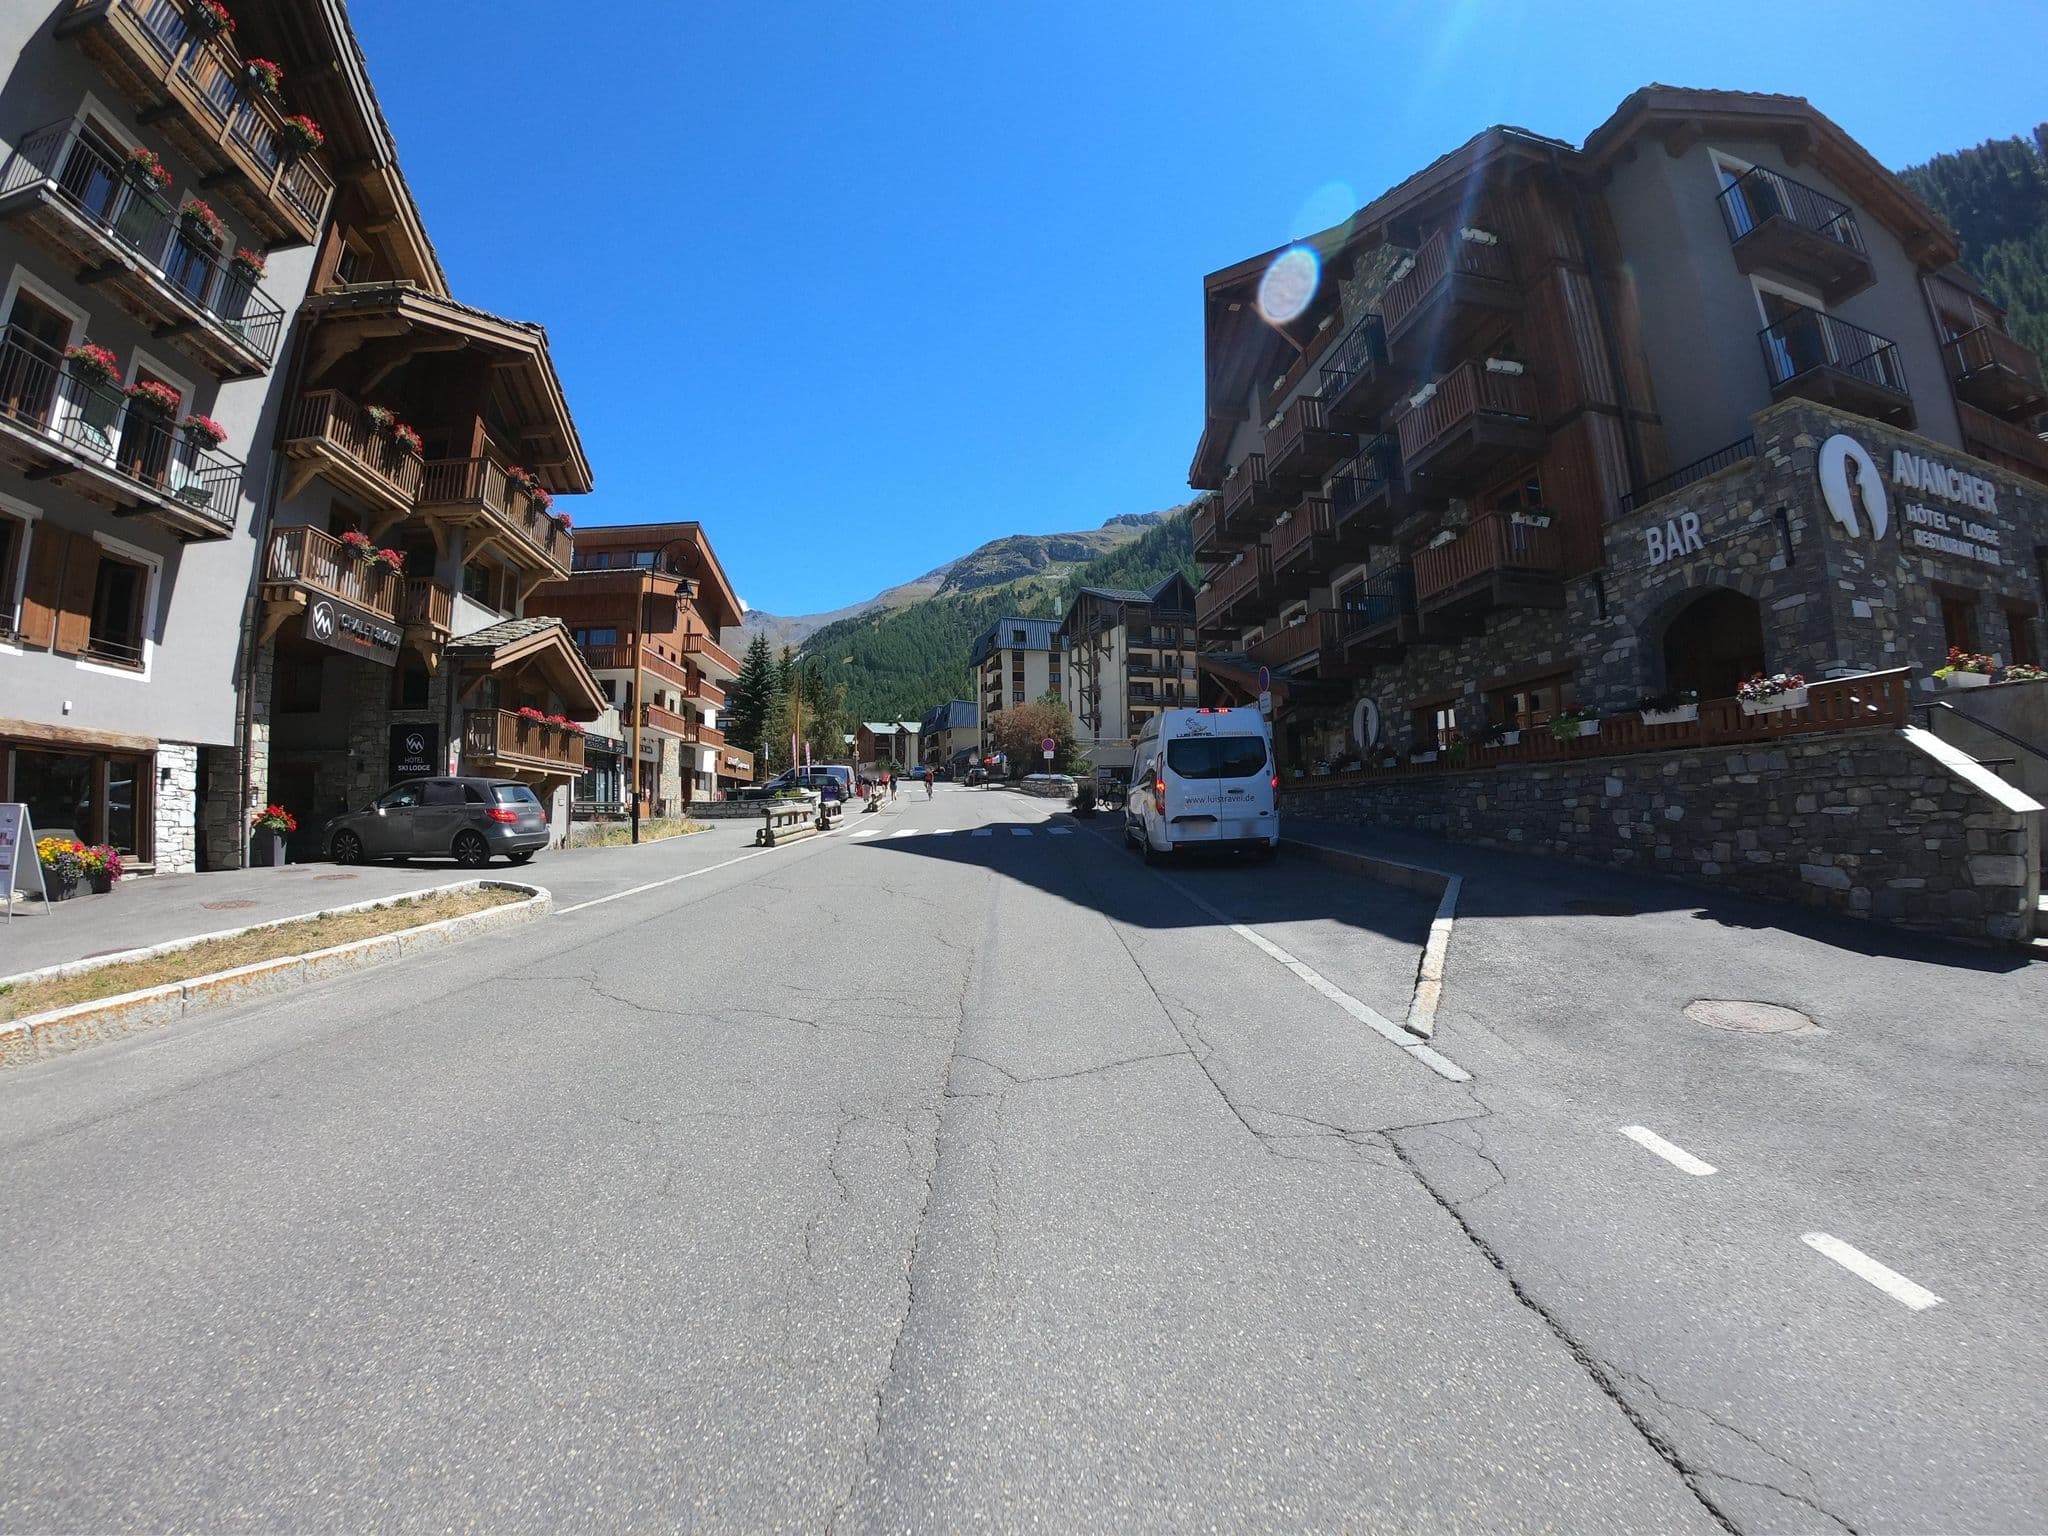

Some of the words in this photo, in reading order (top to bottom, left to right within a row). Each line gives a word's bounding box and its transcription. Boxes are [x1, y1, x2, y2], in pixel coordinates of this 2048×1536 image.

[1893, 450, 1998, 514] AVANCHER
[1646, 512, 1704, 566] BAR
[1913, 529, 1974, 558] RESTAURANT
[1962, 520, 2000, 546] LODGE
[341, 613, 375, 640] CHALET
